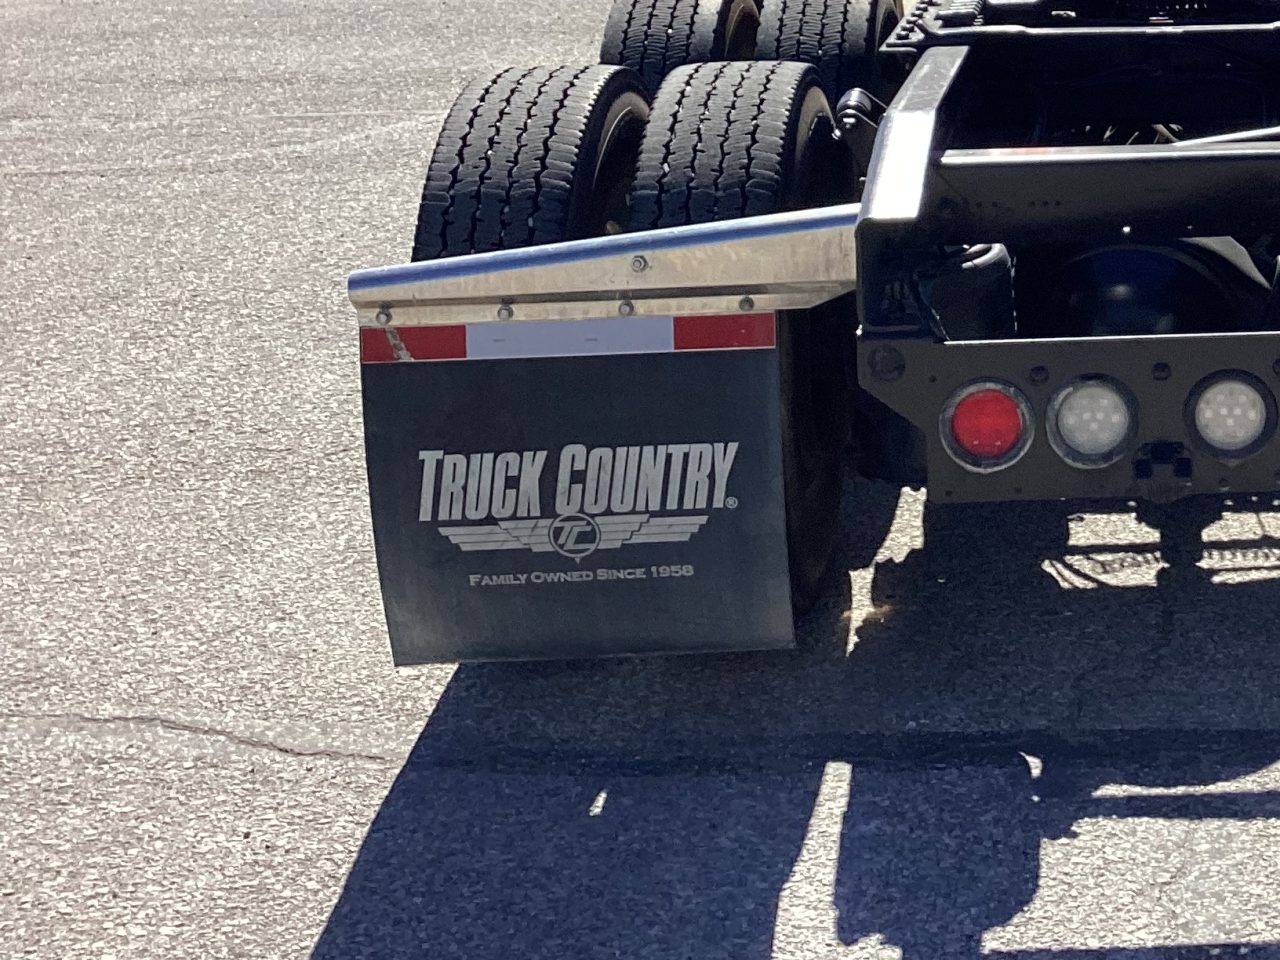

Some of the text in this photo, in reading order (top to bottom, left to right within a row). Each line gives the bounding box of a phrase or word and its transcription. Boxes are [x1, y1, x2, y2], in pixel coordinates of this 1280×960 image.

[418, 442, 739, 522] TRUCK COUNTRY
[468, 564, 695, 587] FAMILY OWNED SINCE 1958
